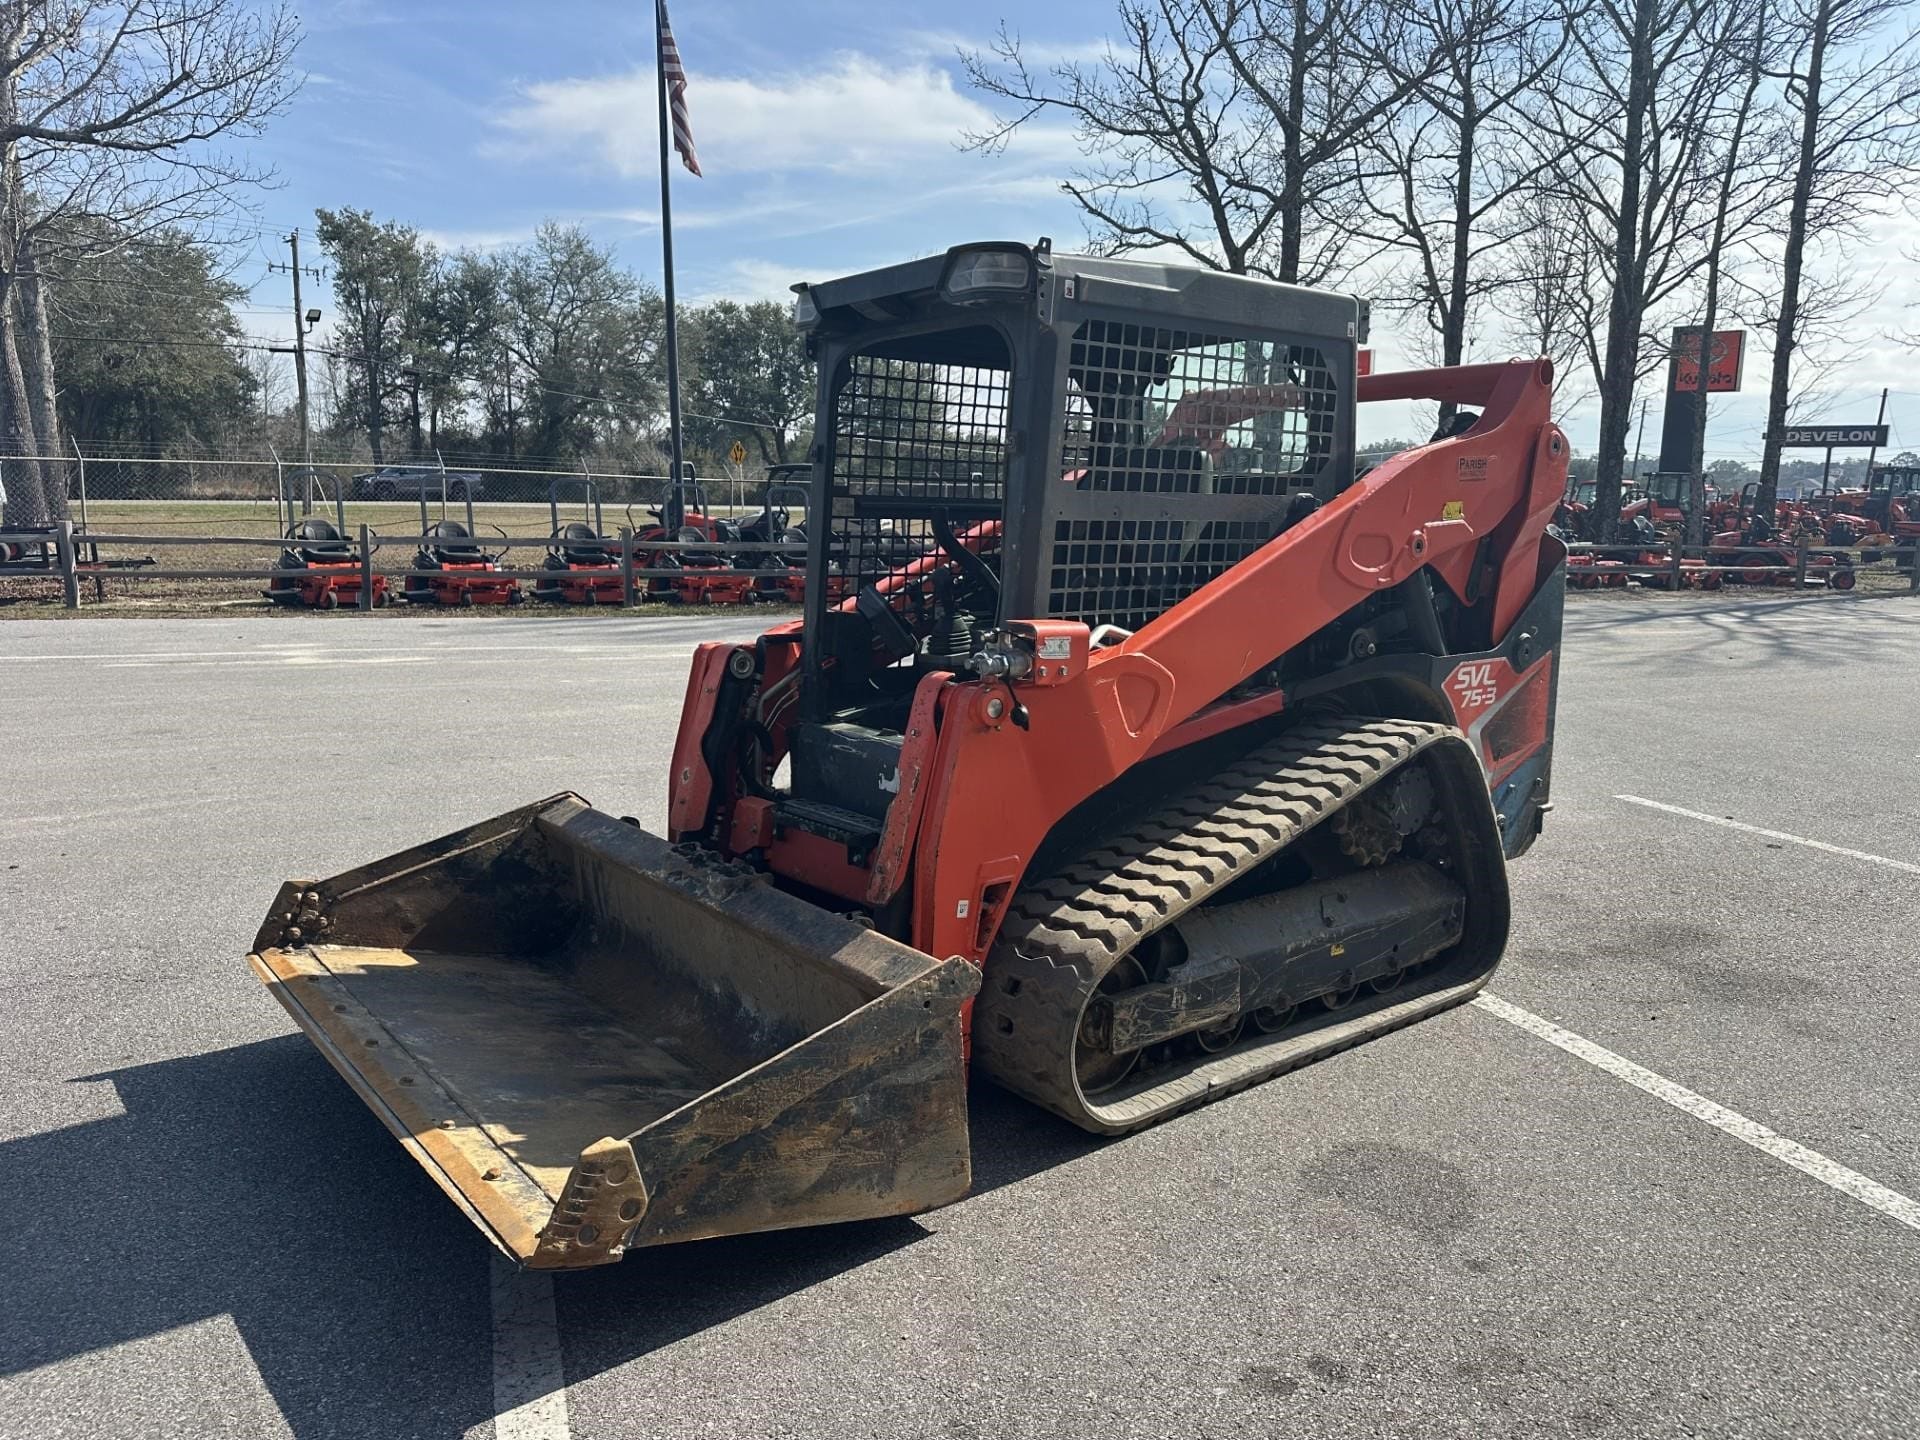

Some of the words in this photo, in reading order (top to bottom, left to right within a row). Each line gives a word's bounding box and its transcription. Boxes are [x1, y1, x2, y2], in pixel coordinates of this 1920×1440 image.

[1679, 371, 1732, 385] Kuota
[1786, 430, 1877, 442] DEVELON
[1453, 664, 1496, 690] SVL
[1460, 687, 1497, 708] 75-3
